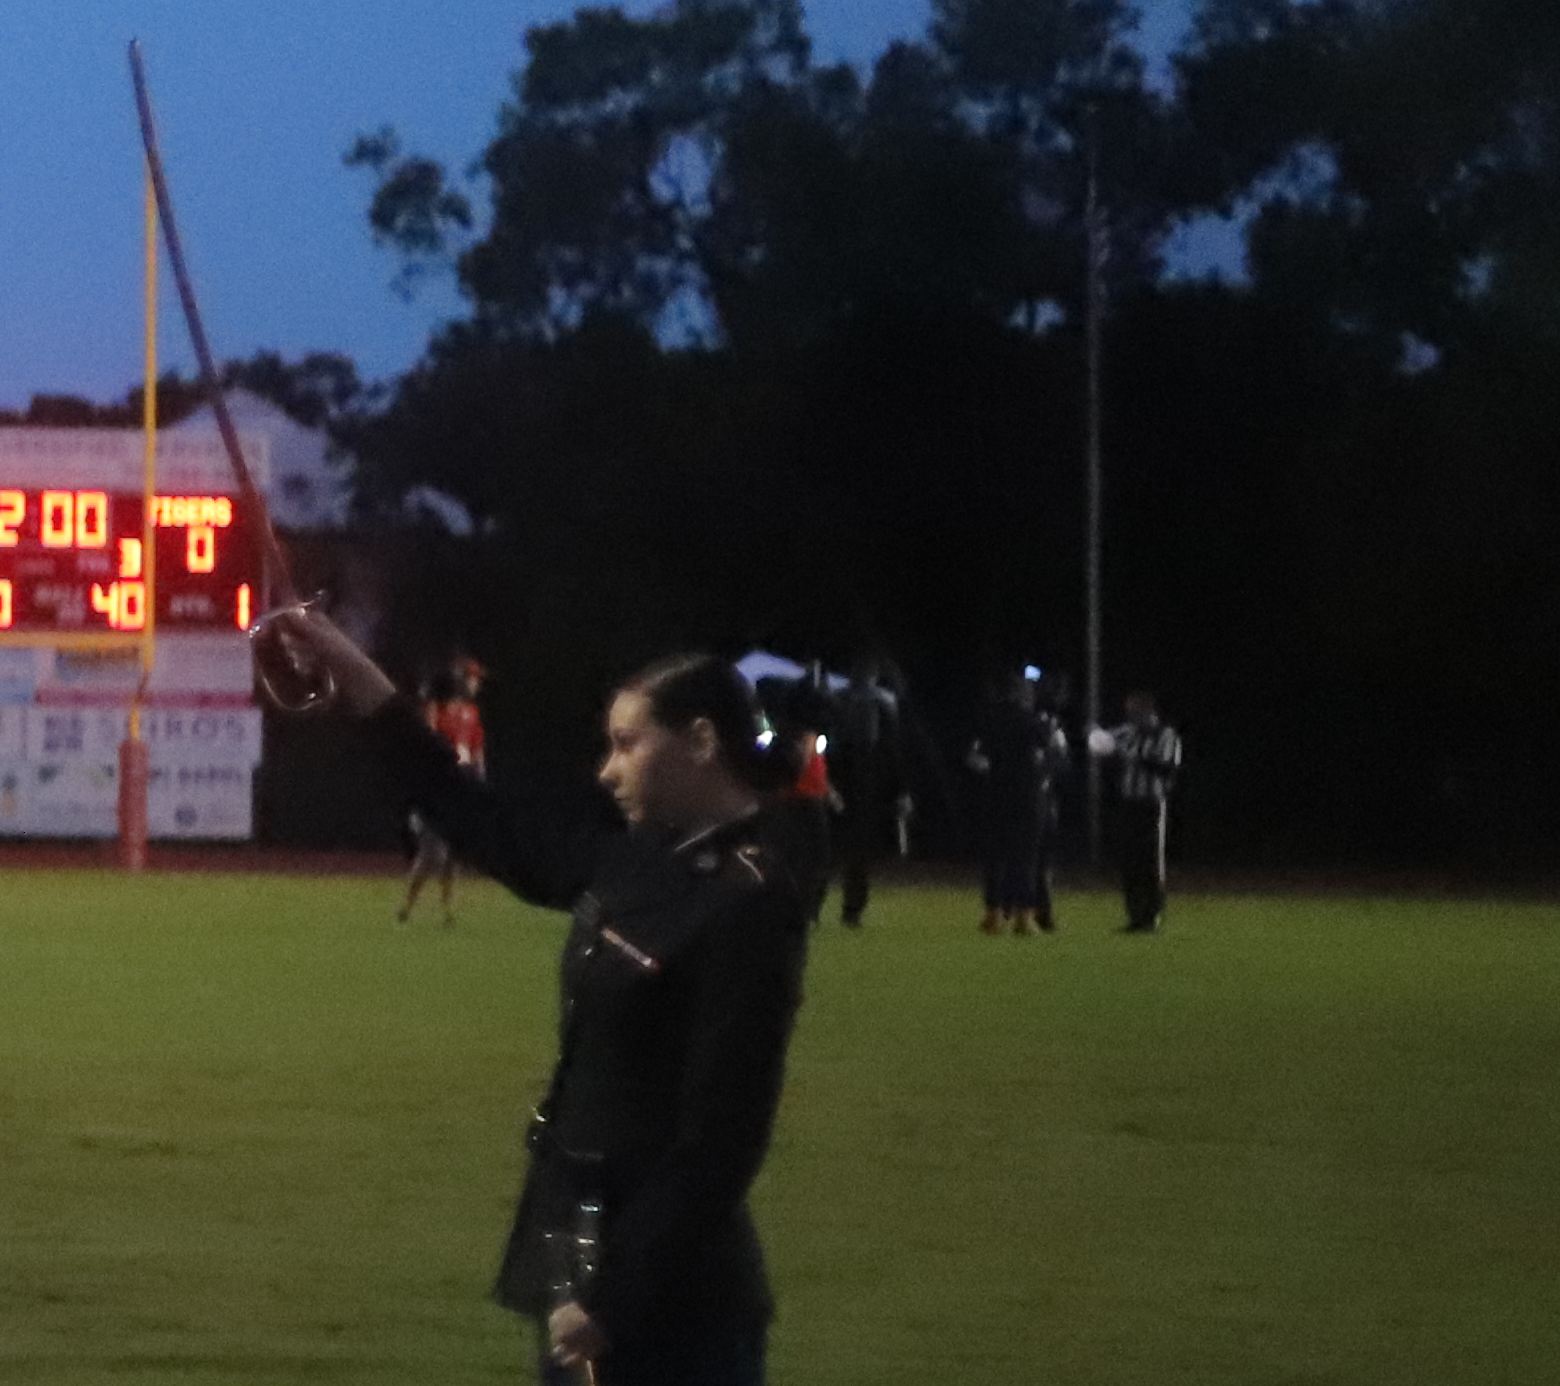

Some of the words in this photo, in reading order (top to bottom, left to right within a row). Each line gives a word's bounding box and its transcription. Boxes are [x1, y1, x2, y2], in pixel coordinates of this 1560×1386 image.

[187, 526, 215, 573] 0
[90, 581, 145, 630] 40
[237, 583, 251, 631] 1
